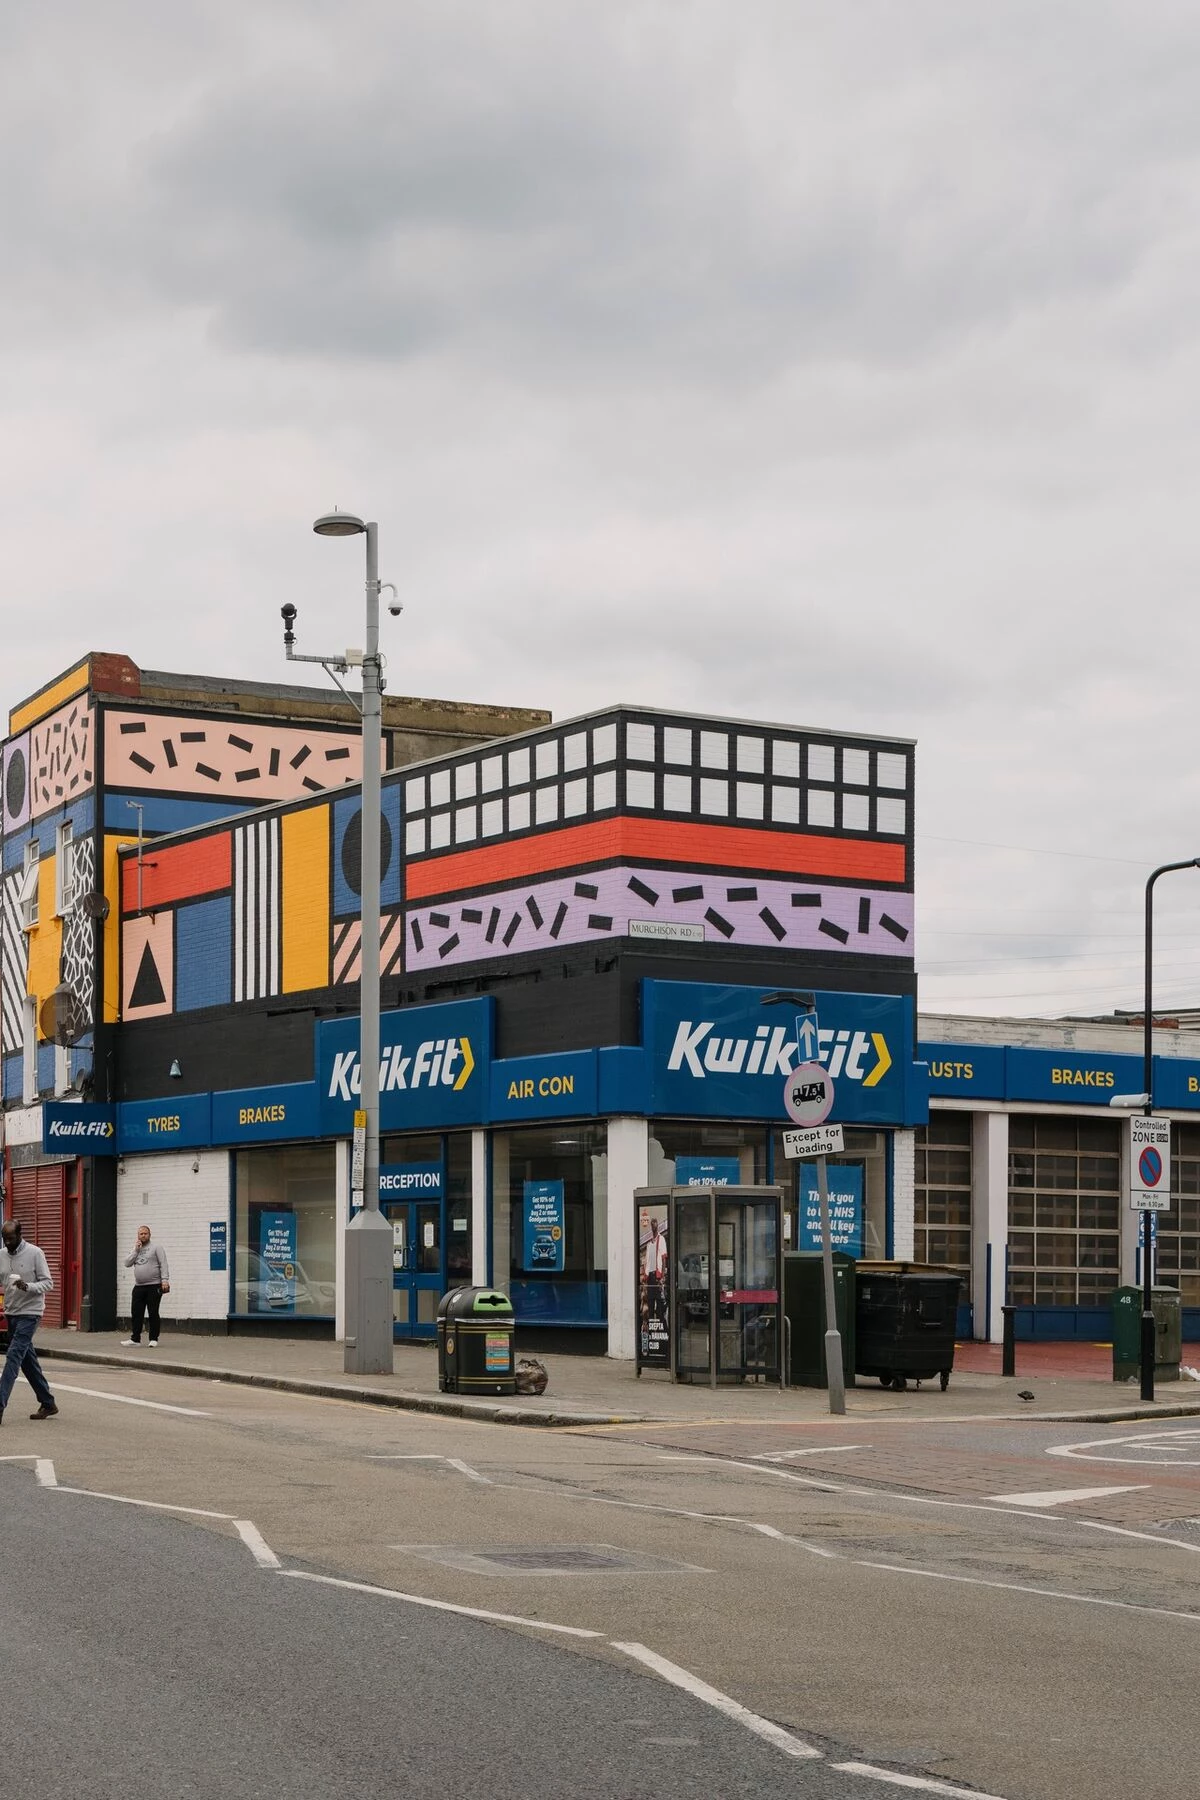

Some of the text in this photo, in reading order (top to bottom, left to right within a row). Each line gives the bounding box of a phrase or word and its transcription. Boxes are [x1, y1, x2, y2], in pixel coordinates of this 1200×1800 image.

[631, 924, 677, 936] MURCHISON
[680, 928, 692, 937] RD
[328, 1045, 412, 1101] Kik
[1051, 1068, 1115, 1087] BRAKES
[507, 1075, 574, 1099] AIR CON
[239, 1105, 286, 1125] BRAKES
[147, 1115, 181, 1133] TYRES
[1134, 1120, 1167, 1131] Controlled
[785, 1128, 840, 1145] Except for
[1132, 1132, 1155, 1143] ZONE
[795, 1141, 833, 1155] loading
[379, 1172, 440, 1190] RECEPTION
[688, 1177, 728, 1186] Get 10% off
[808, 1190, 854, 1205] Thnk you
[806, 1206, 817, 1217] to
[834, 1207, 855, 1218] NHS
[838, 1220, 855, 1233] key
[812, 1233, 849, 1244] wkers
[648, 1322, 664, 1331] SKEPTA
[648, 1342, 660, 1350] CLUB
